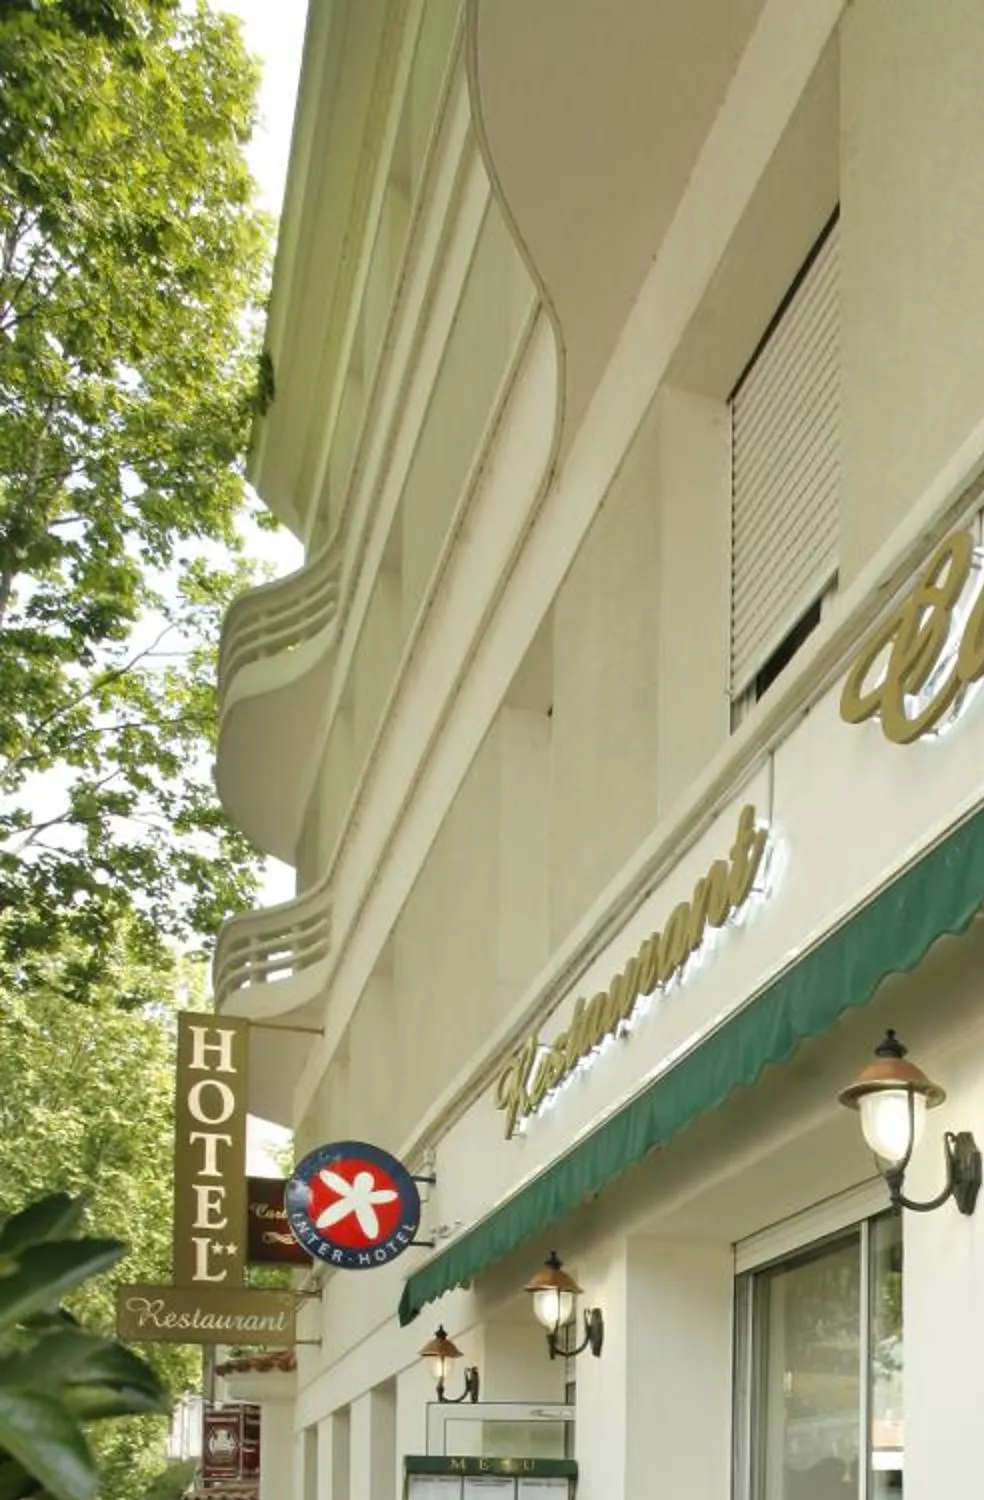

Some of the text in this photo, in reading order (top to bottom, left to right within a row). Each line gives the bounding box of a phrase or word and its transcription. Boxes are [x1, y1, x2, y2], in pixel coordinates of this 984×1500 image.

[187, 1025, 238, 1283] HOTEL
[125, 1296, 289, 1332] Restaurant
[450, 1459, 535, 1471] MEU
